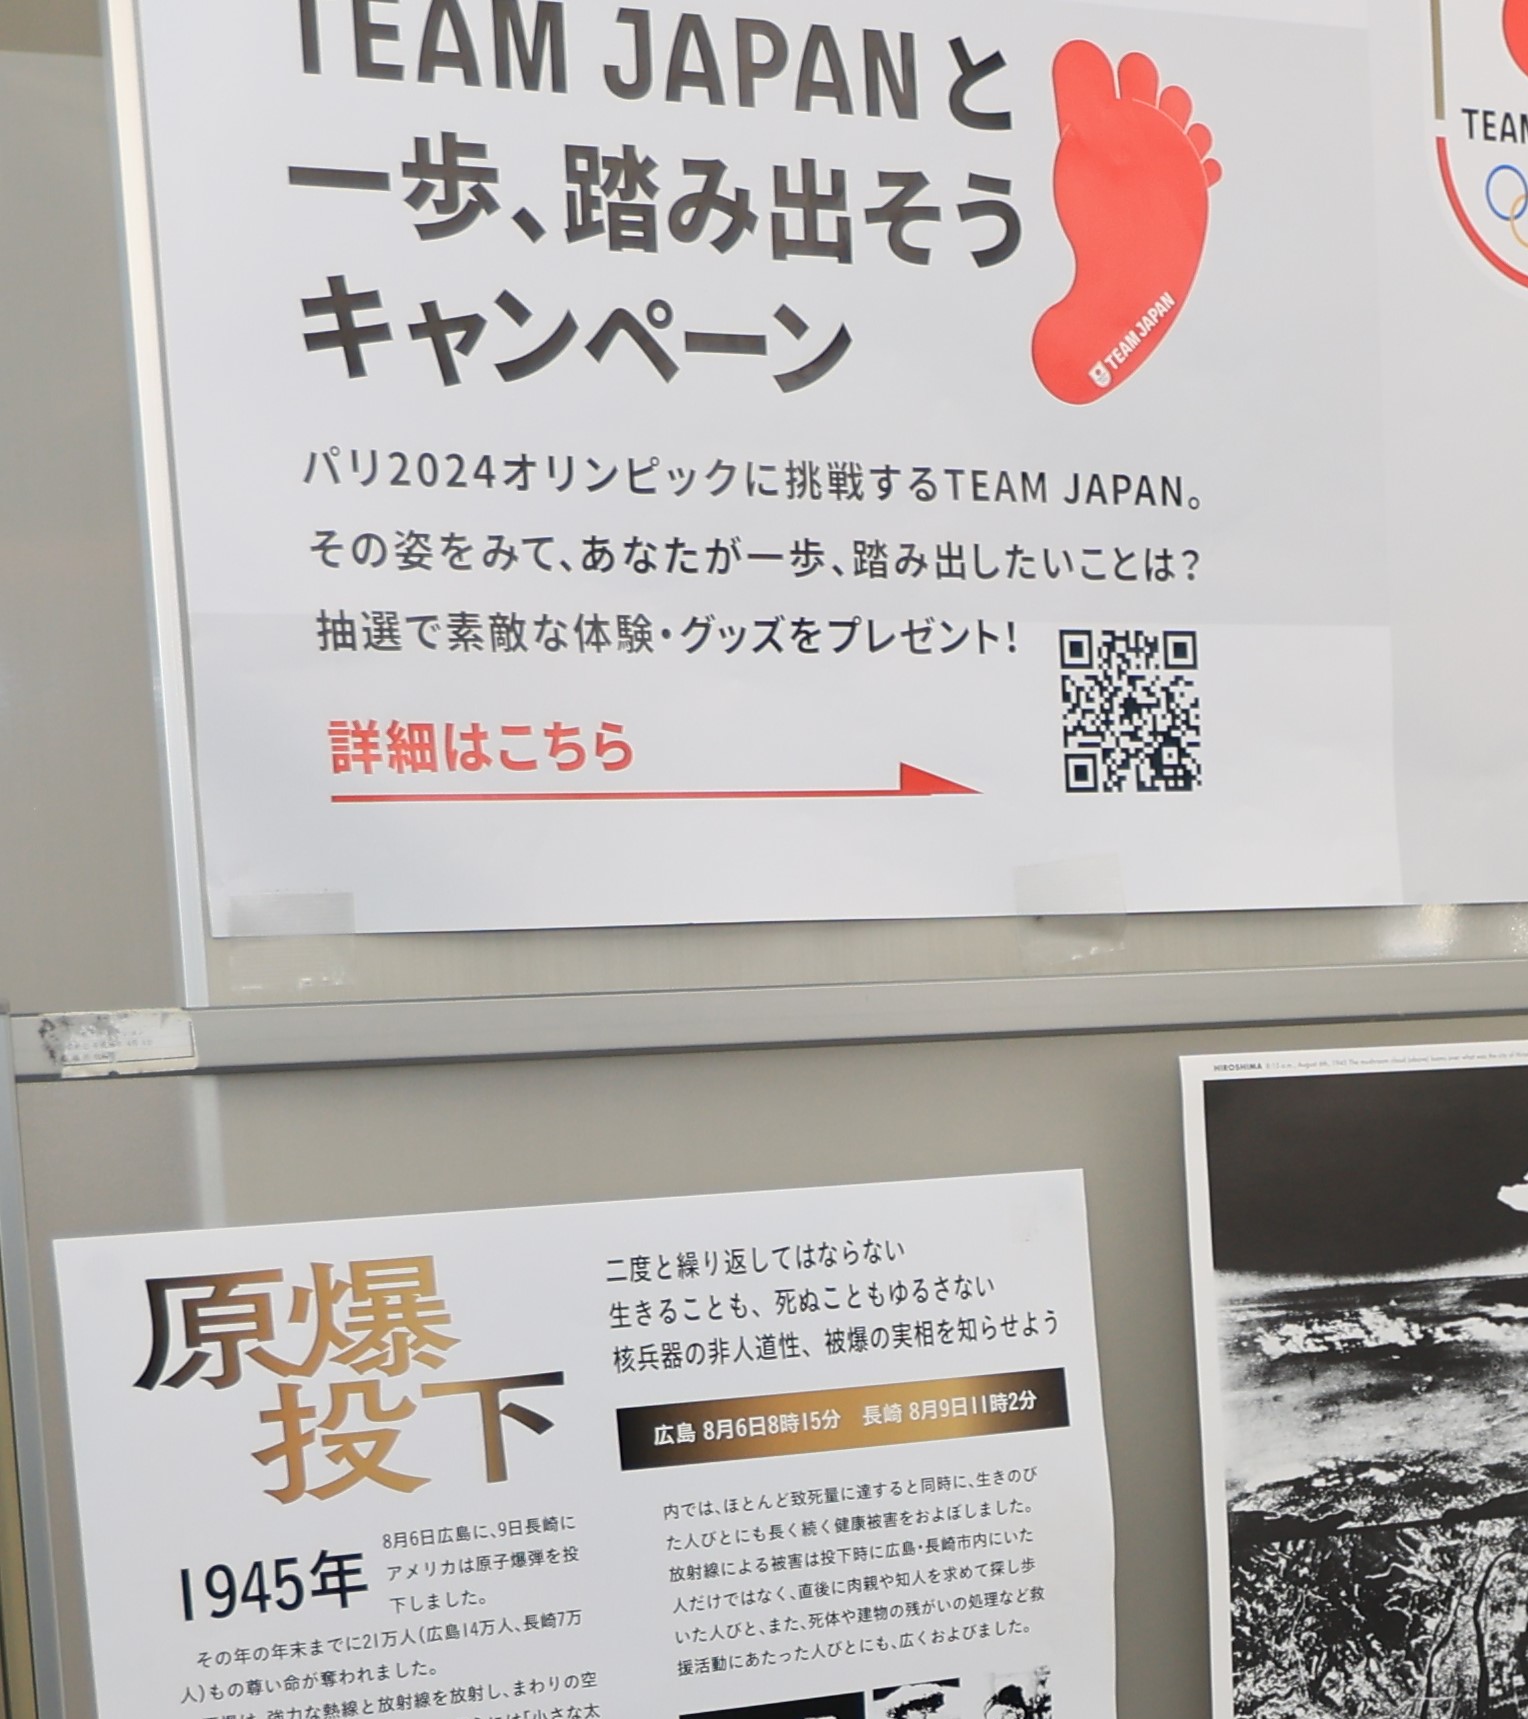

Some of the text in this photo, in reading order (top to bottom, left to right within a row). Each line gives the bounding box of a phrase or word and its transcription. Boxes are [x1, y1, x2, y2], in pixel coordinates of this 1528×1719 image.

[297, 0, 569, 94] TEAM
[287, 131, 1022, 270] 一歩、踏み出そう
[301, 275, 853, 394] キャンペーン
[1104, 291, 1176, 369] TEAM JAPAN
[302, 449, 1202, 512] パリ2024オリンピックに挑戦するTEAM JAPAN。
[310, 530, 1201, 582] その姿をみて、あなたが一歩、踏み出したいことは？
[328, 719, 635, 775] 詳細はこちら
[1213, 1062, 1262, 1072] HIROSHIMA
[606, 1238, 906, 1284] 二度と繰り返してはならない
[134, 1255, 462, 1390] 原爆
[609, 1273, 996, 1330] 生きることも、死ぬこともゆるさない
[613, 1309, 1059, 1374] 核兵器の非人道性、被爆の実相を知らせよう
[252, 1370, 564, 1505] 投下
[654, 1389, 1038, 1447] 広島 8月6日8時15分 長崎 8月9日11時2分
[382, 1514, 577, 1551] 8月6日広島に、9日長崎に
[180, 1549, 368, 1622] 1945年
[387, 1545, 580, 1583] アメリカは原子爆弾を投
[389, 1589, 488, 1615] 下しました。
